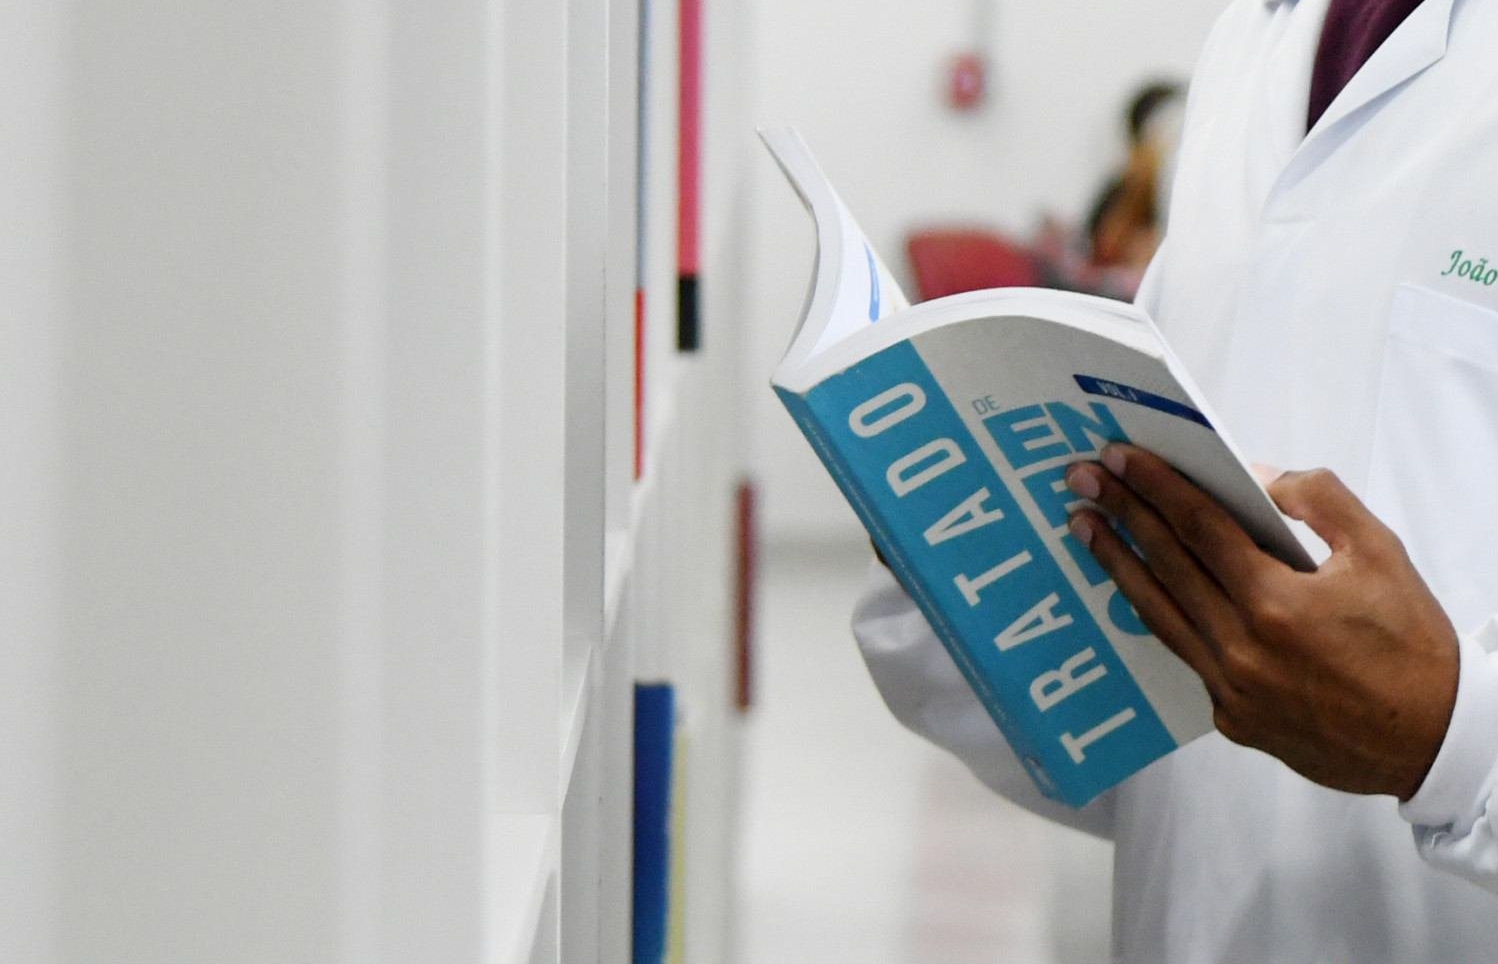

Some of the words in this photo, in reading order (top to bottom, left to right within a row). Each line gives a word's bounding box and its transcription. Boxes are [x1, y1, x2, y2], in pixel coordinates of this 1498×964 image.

[1441, 250, 1498, 286] João
[971, 395, 1000, 416] DE
[848, 381, 1137, 765] TRATADO
